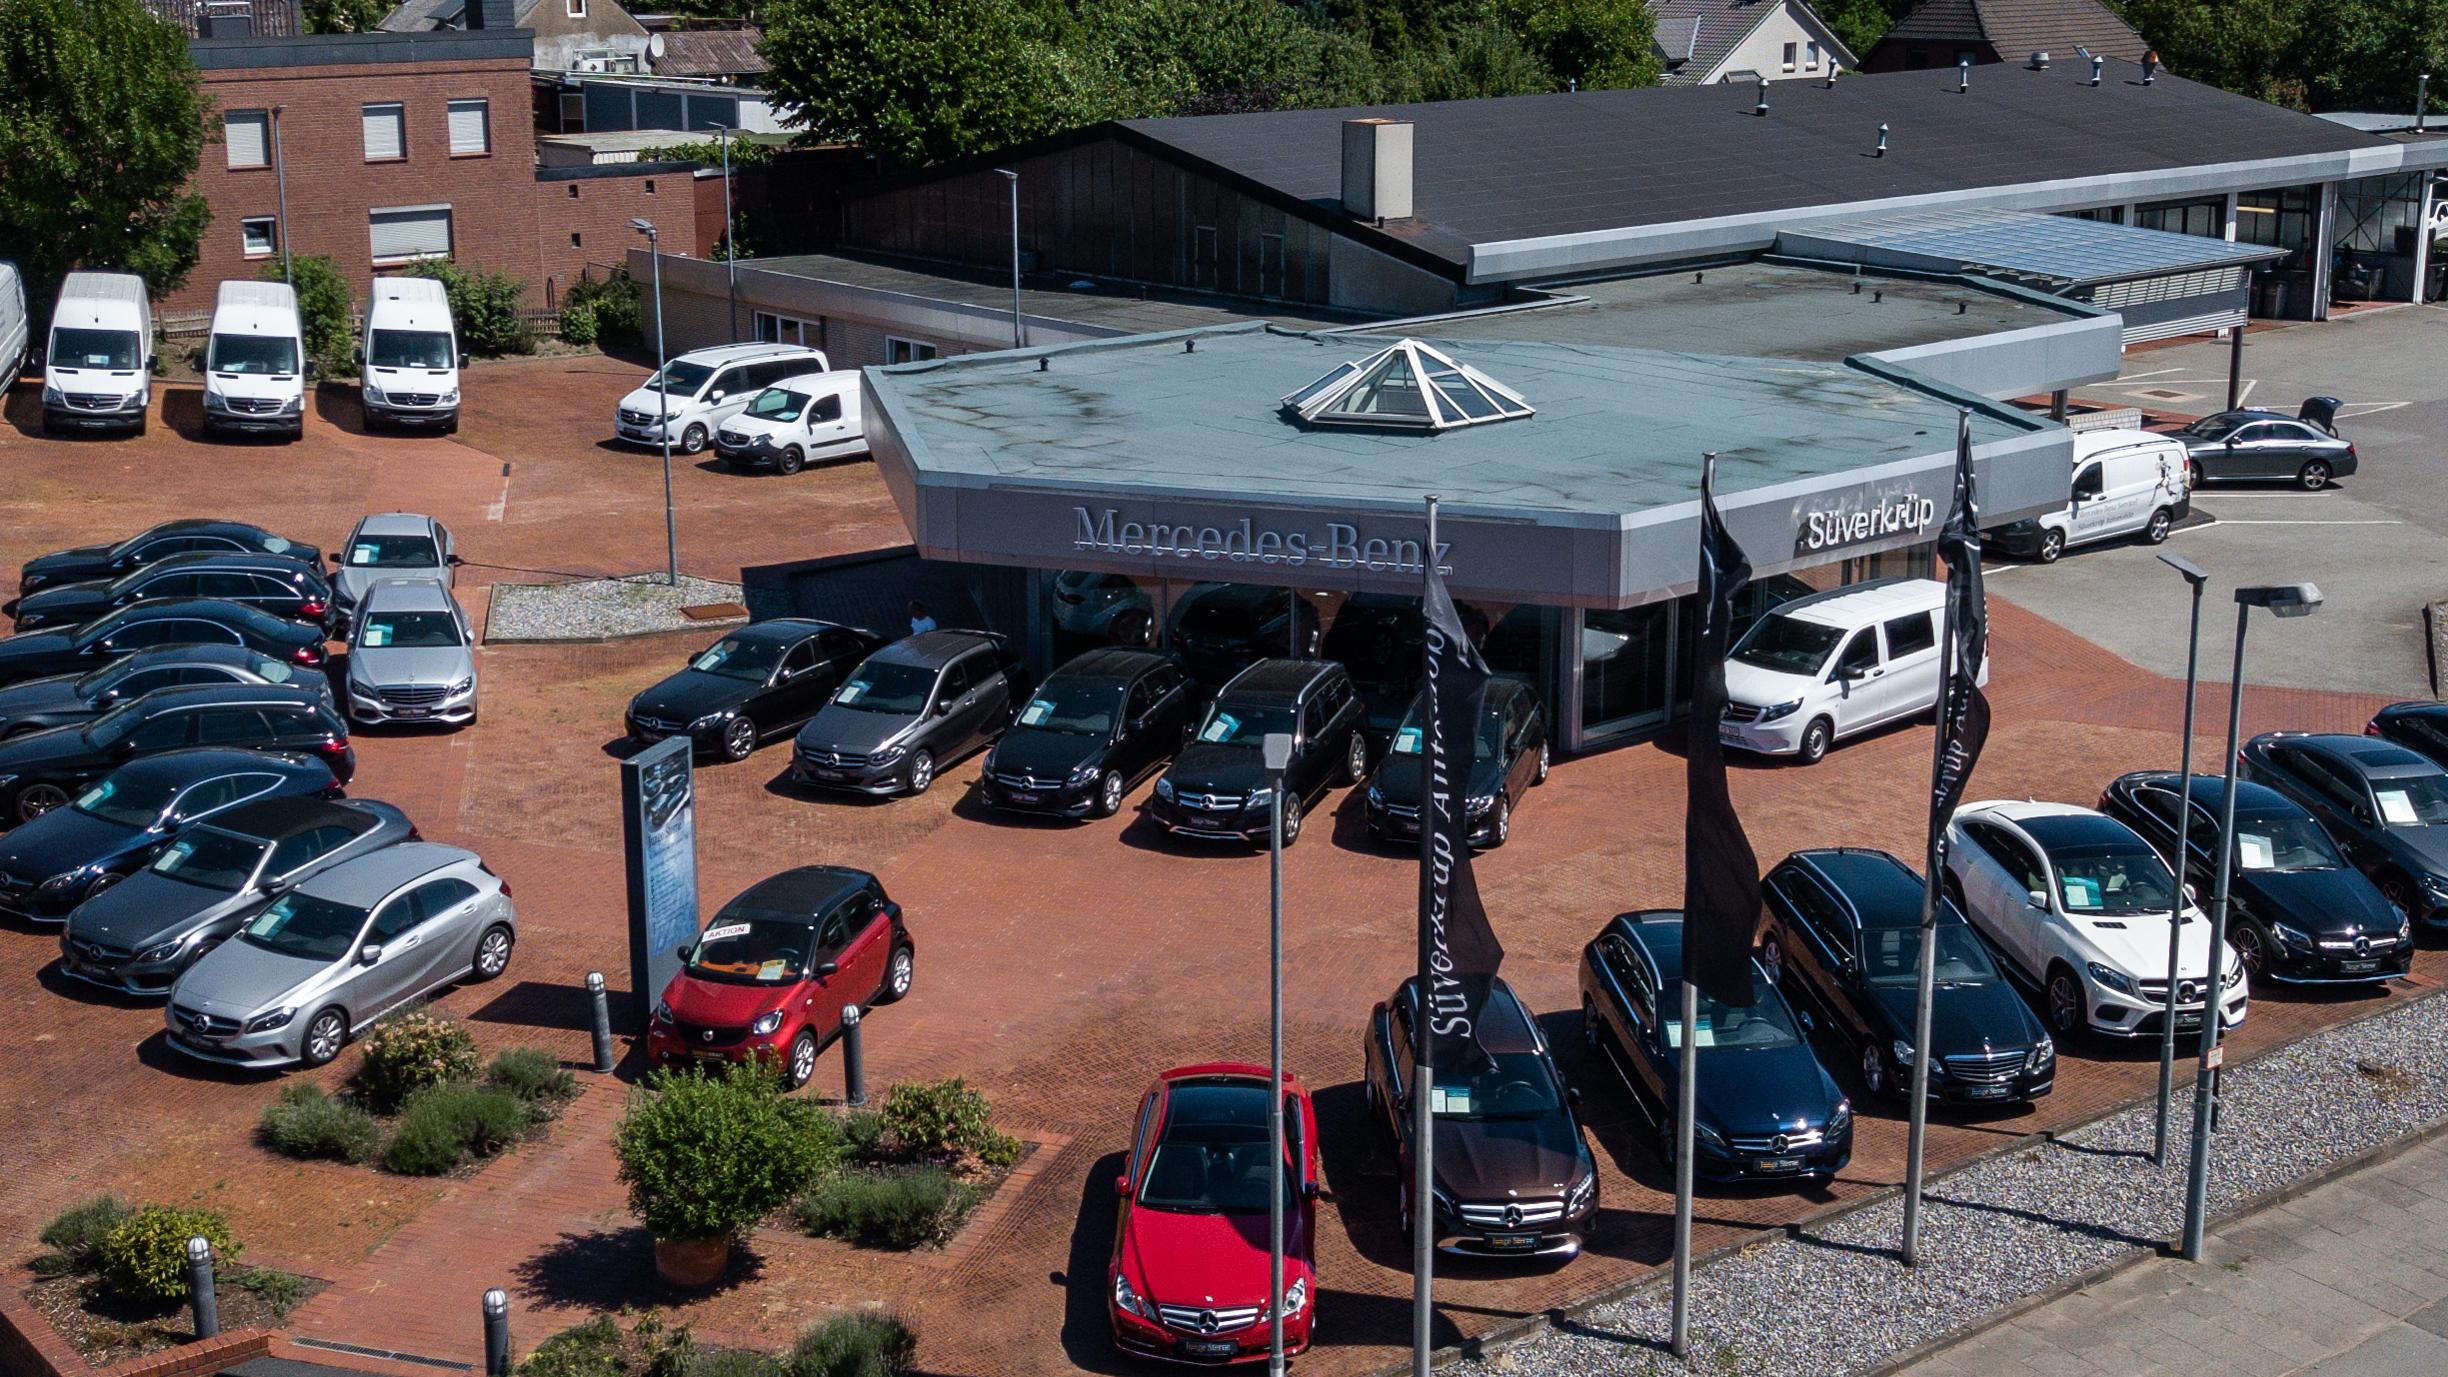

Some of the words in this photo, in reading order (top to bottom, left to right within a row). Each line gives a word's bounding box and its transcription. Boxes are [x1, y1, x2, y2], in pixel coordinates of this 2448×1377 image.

[1073, 507, 1452, 576] Mercedes-Benz
[1808, 494, 1934, 549] Süverkrüp
[708, 926, 745, 938] AKTION
